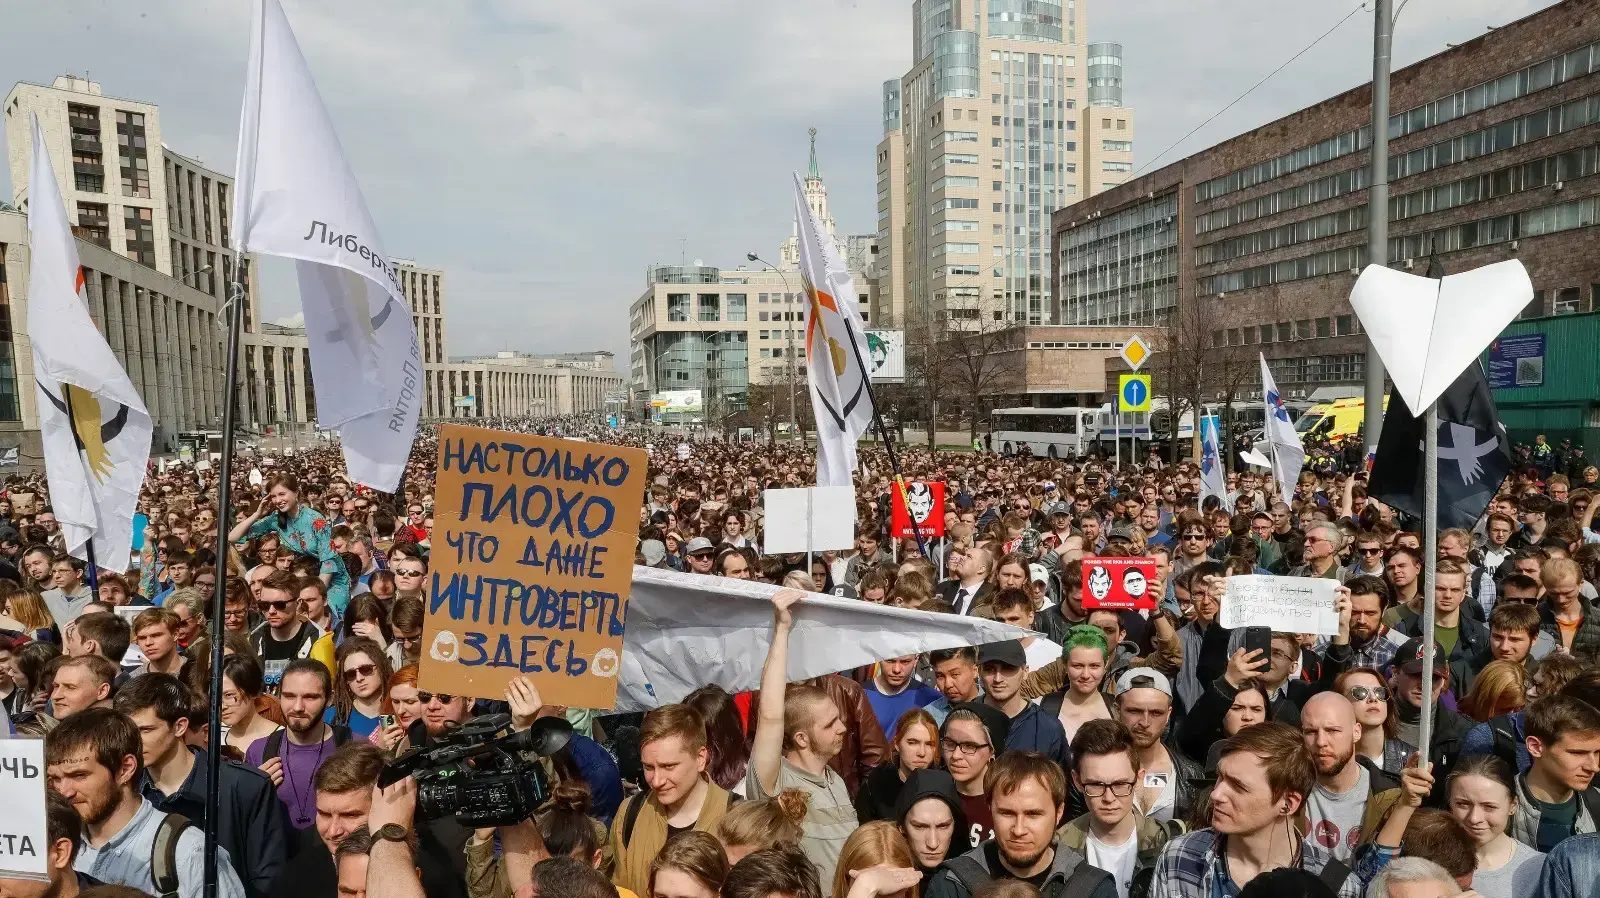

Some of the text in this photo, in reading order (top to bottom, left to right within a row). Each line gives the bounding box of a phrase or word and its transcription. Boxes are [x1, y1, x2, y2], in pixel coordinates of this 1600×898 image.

[443, 438, 630, 487] НАСТОЛЬКО
[459, 482, 616, 539] ПЛОХО
[446, 530, 608, 579] ЧТО ДАЖЕ
[429, 570, 629, 638] ИНТРОВЕРТЫ
[458, 632, 588, 677] ЗДЕСЬ
[0, 757, 39, 779] ЧЬ
